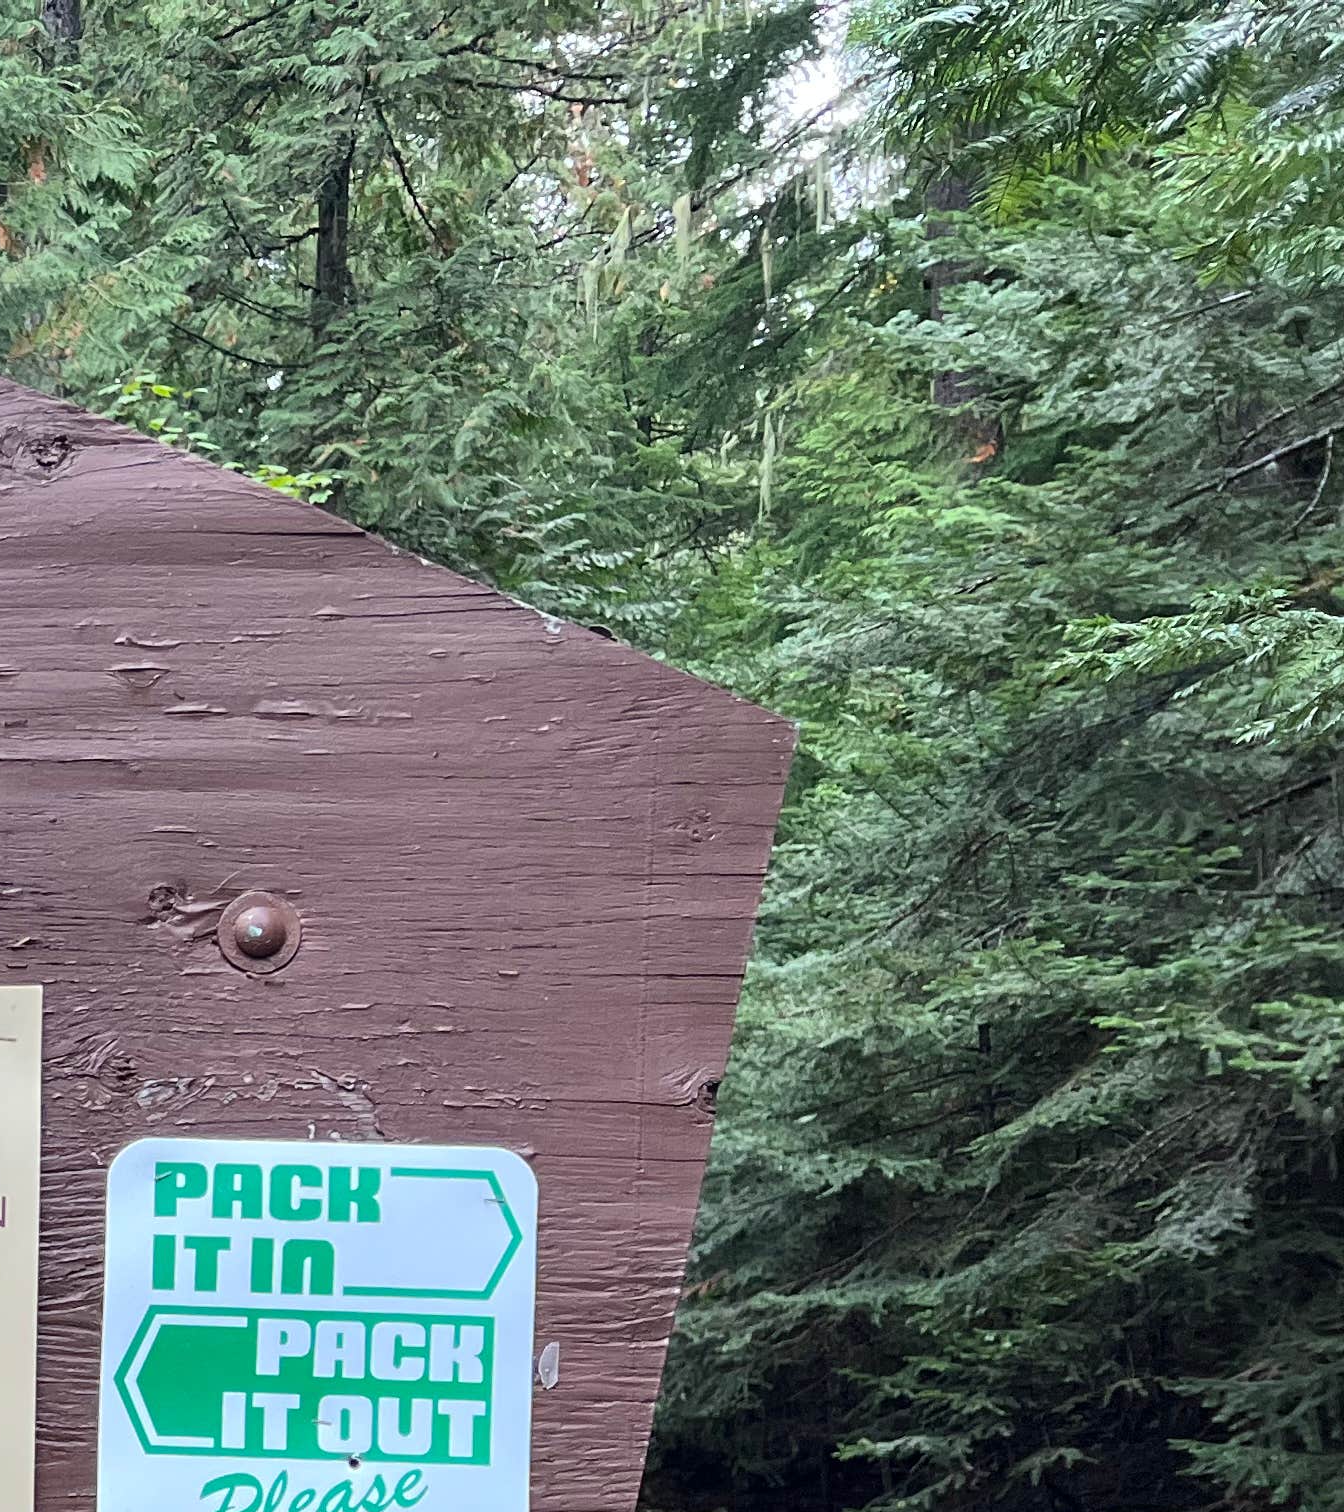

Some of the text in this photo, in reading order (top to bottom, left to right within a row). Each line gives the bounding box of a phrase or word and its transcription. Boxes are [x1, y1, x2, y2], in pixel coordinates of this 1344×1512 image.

[154, 1161, 381, 1222] PACK
[152, 1234, 230, 1292] IT
[255, 1317, 484, 1383] PACK
[221, 1391, 486, 1457] IT OUT
